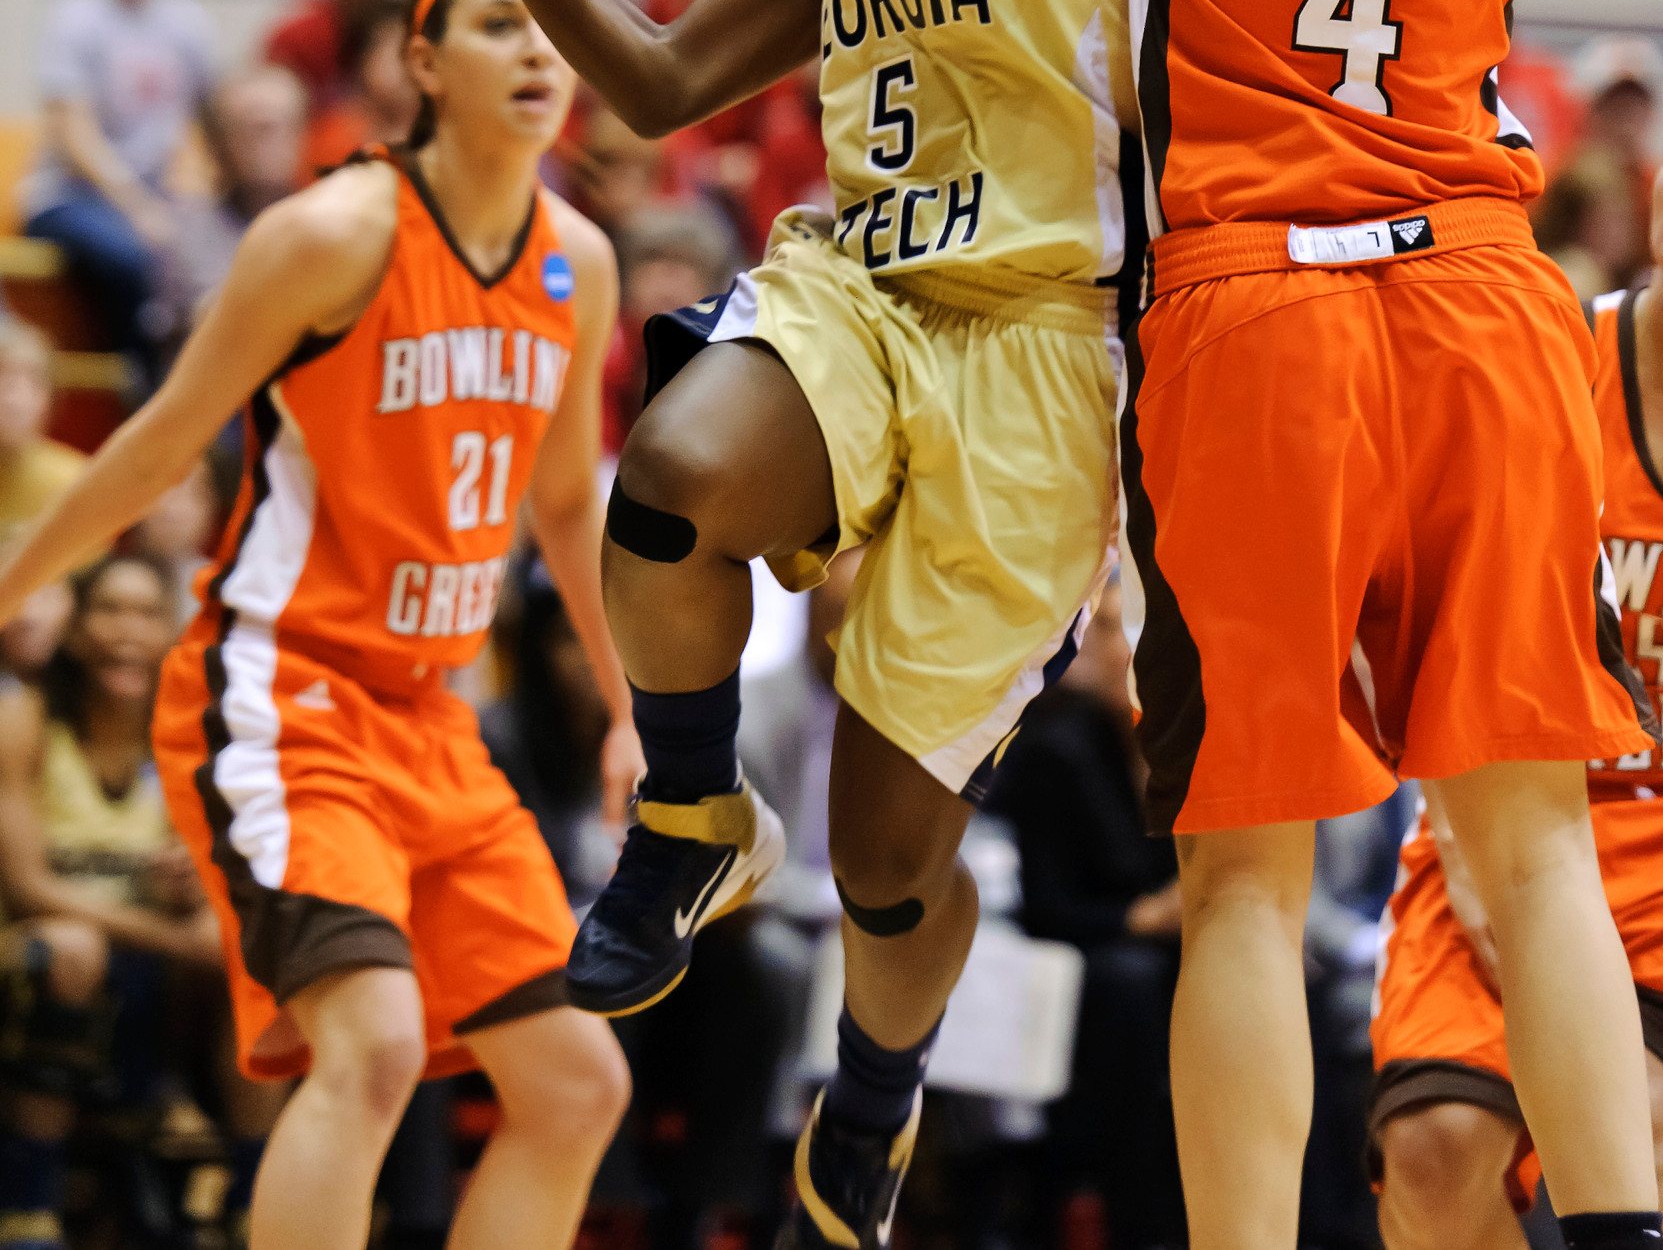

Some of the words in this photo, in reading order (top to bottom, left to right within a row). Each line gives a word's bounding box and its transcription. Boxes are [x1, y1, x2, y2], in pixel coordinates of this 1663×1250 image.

[866, 53, 918, 174] 5
[838, 170, 984, 270] TECH
[449, 431, 514, 531] 21
